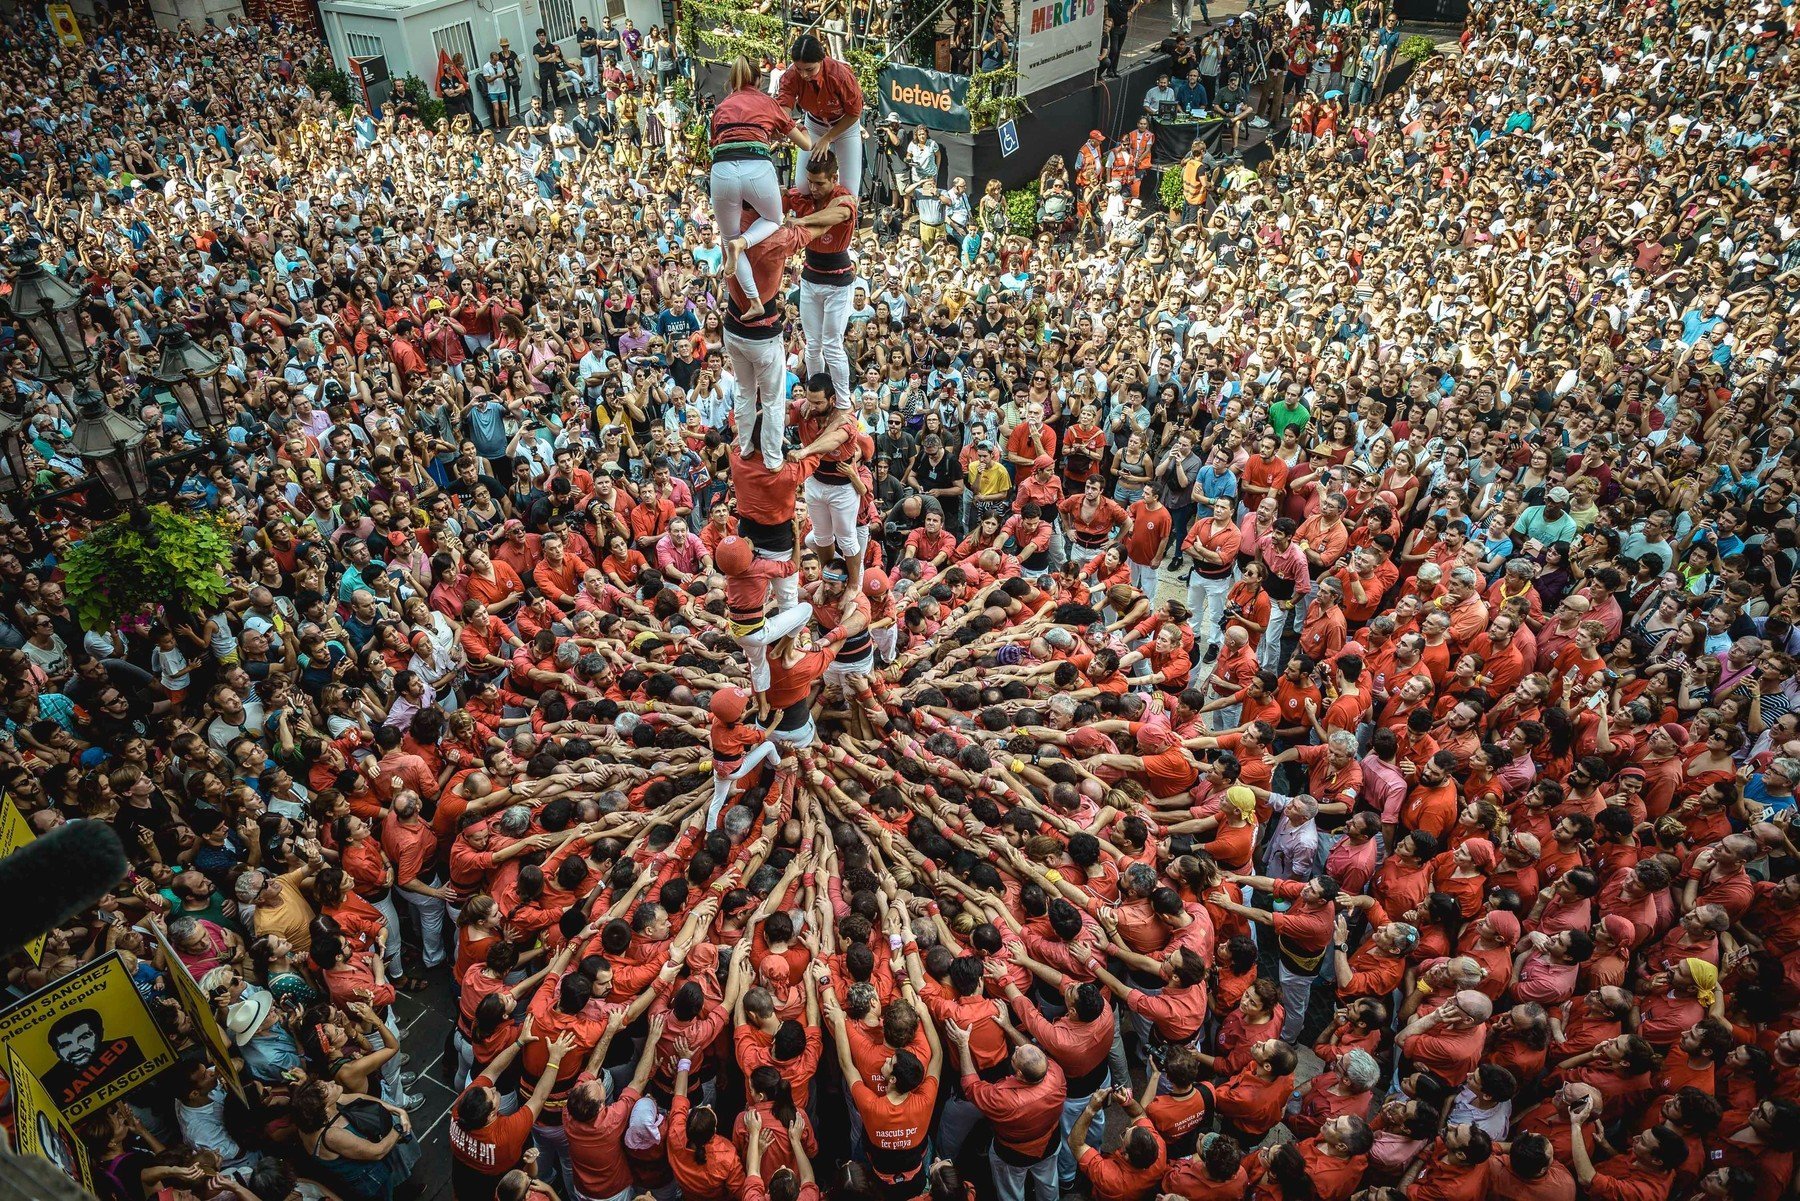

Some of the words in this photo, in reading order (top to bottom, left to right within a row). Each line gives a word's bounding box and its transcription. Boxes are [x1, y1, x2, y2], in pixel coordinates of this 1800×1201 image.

[891, 79, 952, 112] betevé
[667, 322, 690, 331] DAKOTA
[0, 1005, 38, 1030] ORDI
[40, 964, 112, 1007] SANCHEZ
[1, 1008, 56, 1043] elected
[59, 980, 107, 1011] deputy
[61, 1097, 93, 1121] TOP
[96, 1052, 170, 1101] FASCISM
[63, 1039, 128, 1103] JAILED
[875, 1129, 904, 1137] nascuts
[905, 1127, 918, 1138] per
[881, 1139, 892, 1148] fer
[892, 1139, 912, 1149] pinya
[479, 1142, 496, 1166] PIT
